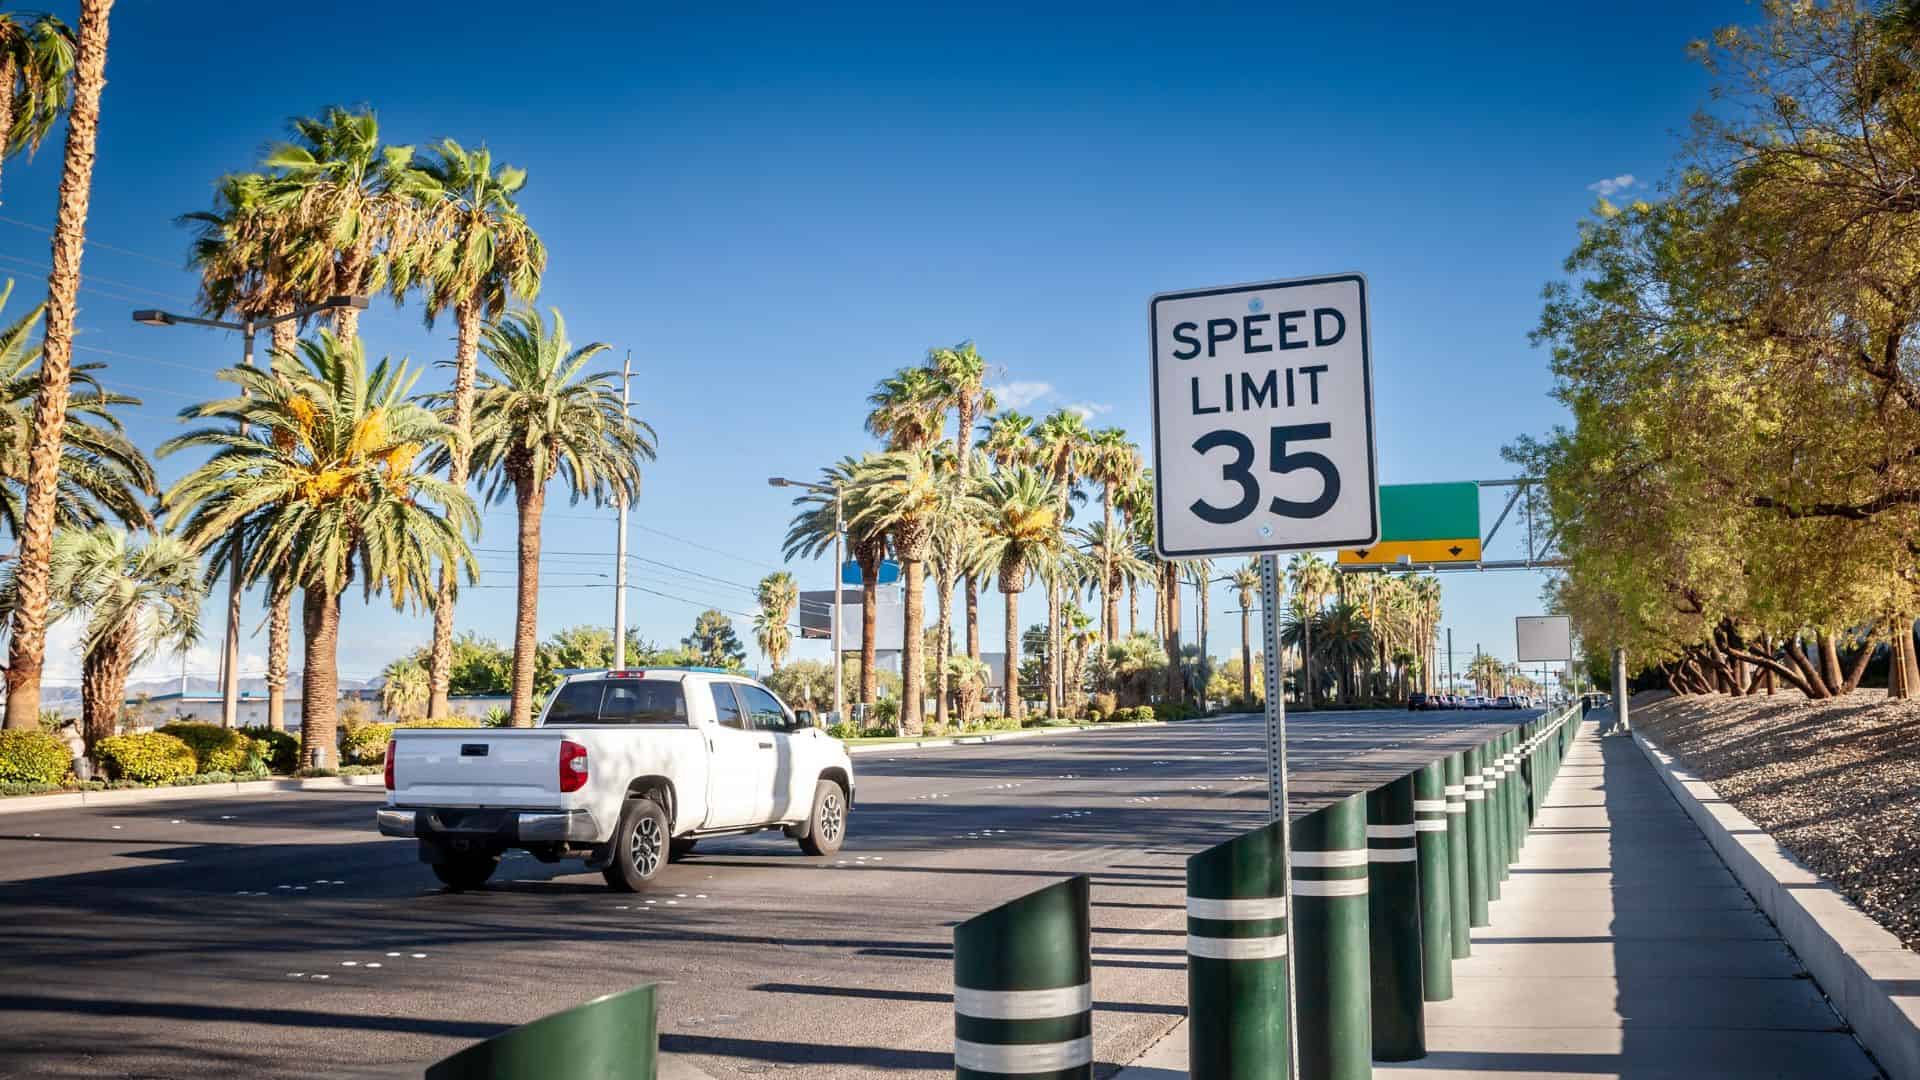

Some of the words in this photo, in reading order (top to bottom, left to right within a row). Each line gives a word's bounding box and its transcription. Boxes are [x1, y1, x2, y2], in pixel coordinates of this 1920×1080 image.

[1172, 307, 1347, 361] SPEED
[1191, 364, 1329, 416] LIMIT
[1189, 421, 1341, 525] 35
